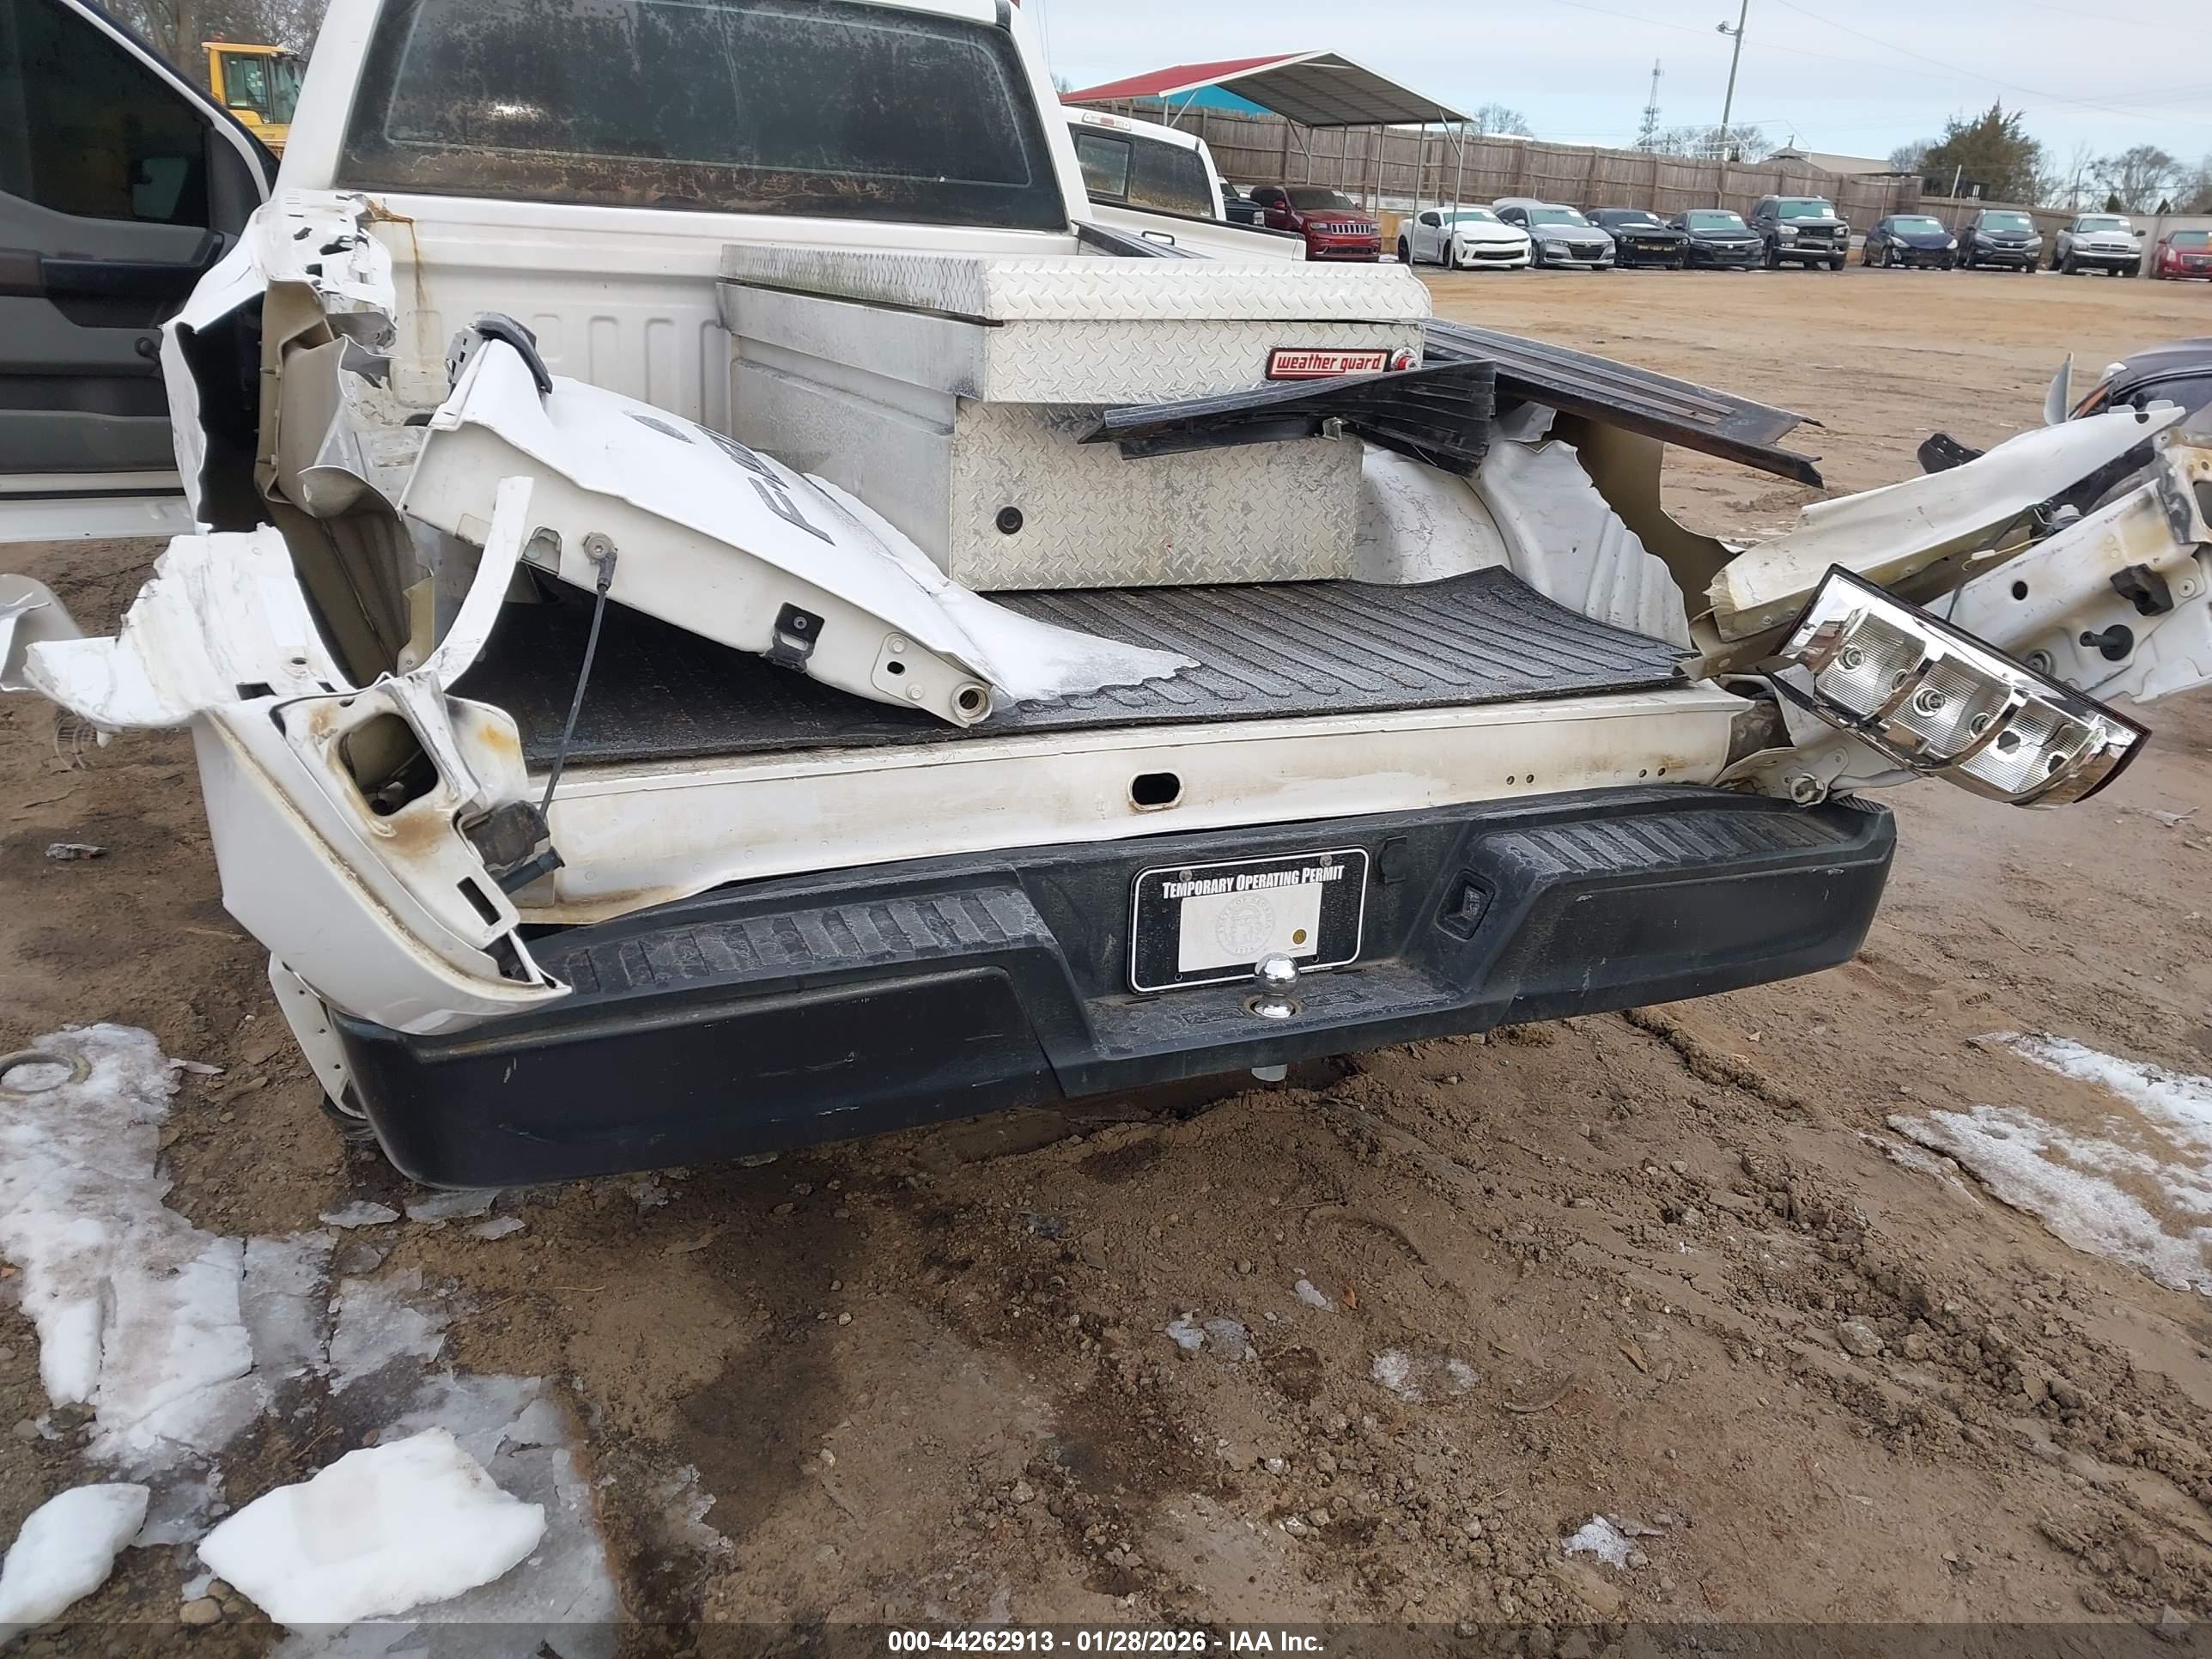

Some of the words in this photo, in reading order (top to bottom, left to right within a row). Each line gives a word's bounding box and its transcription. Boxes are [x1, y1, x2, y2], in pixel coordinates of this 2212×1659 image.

[1277, 354, 1337, 369] weather
[1340, 355, 1382, 372] guard
[1163, 878, 1234, 899] TEMPORARY
[1236, 871, 1300, 891] OPERATING
[1302, 865, 1345, 884] PERMIT
